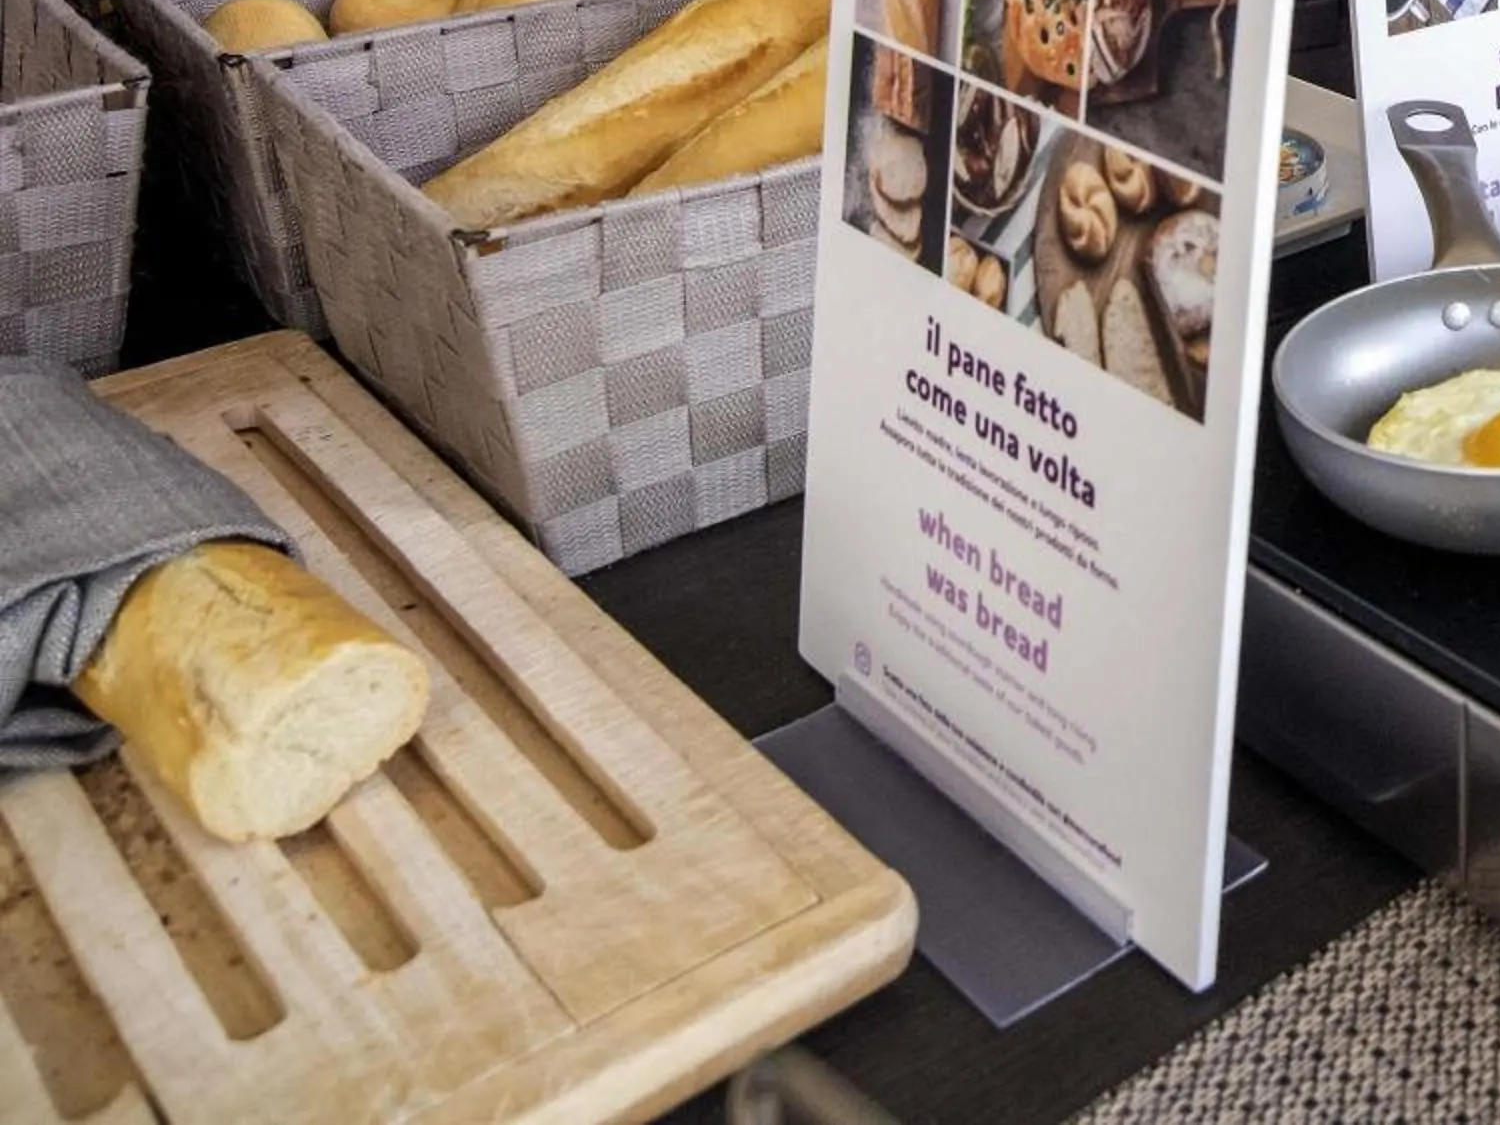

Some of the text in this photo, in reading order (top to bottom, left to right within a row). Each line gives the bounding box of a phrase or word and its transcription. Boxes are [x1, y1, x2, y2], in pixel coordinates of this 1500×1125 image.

[905, 368, 1096, 509] come una volta
[926, 315, 1078, 439] il pane fatto
[918, 507, 982, 572] when
[990, 548, 1063, 630] bread
[926, 563, 969, 615] was
[976, 592, 1049, 674] bread
